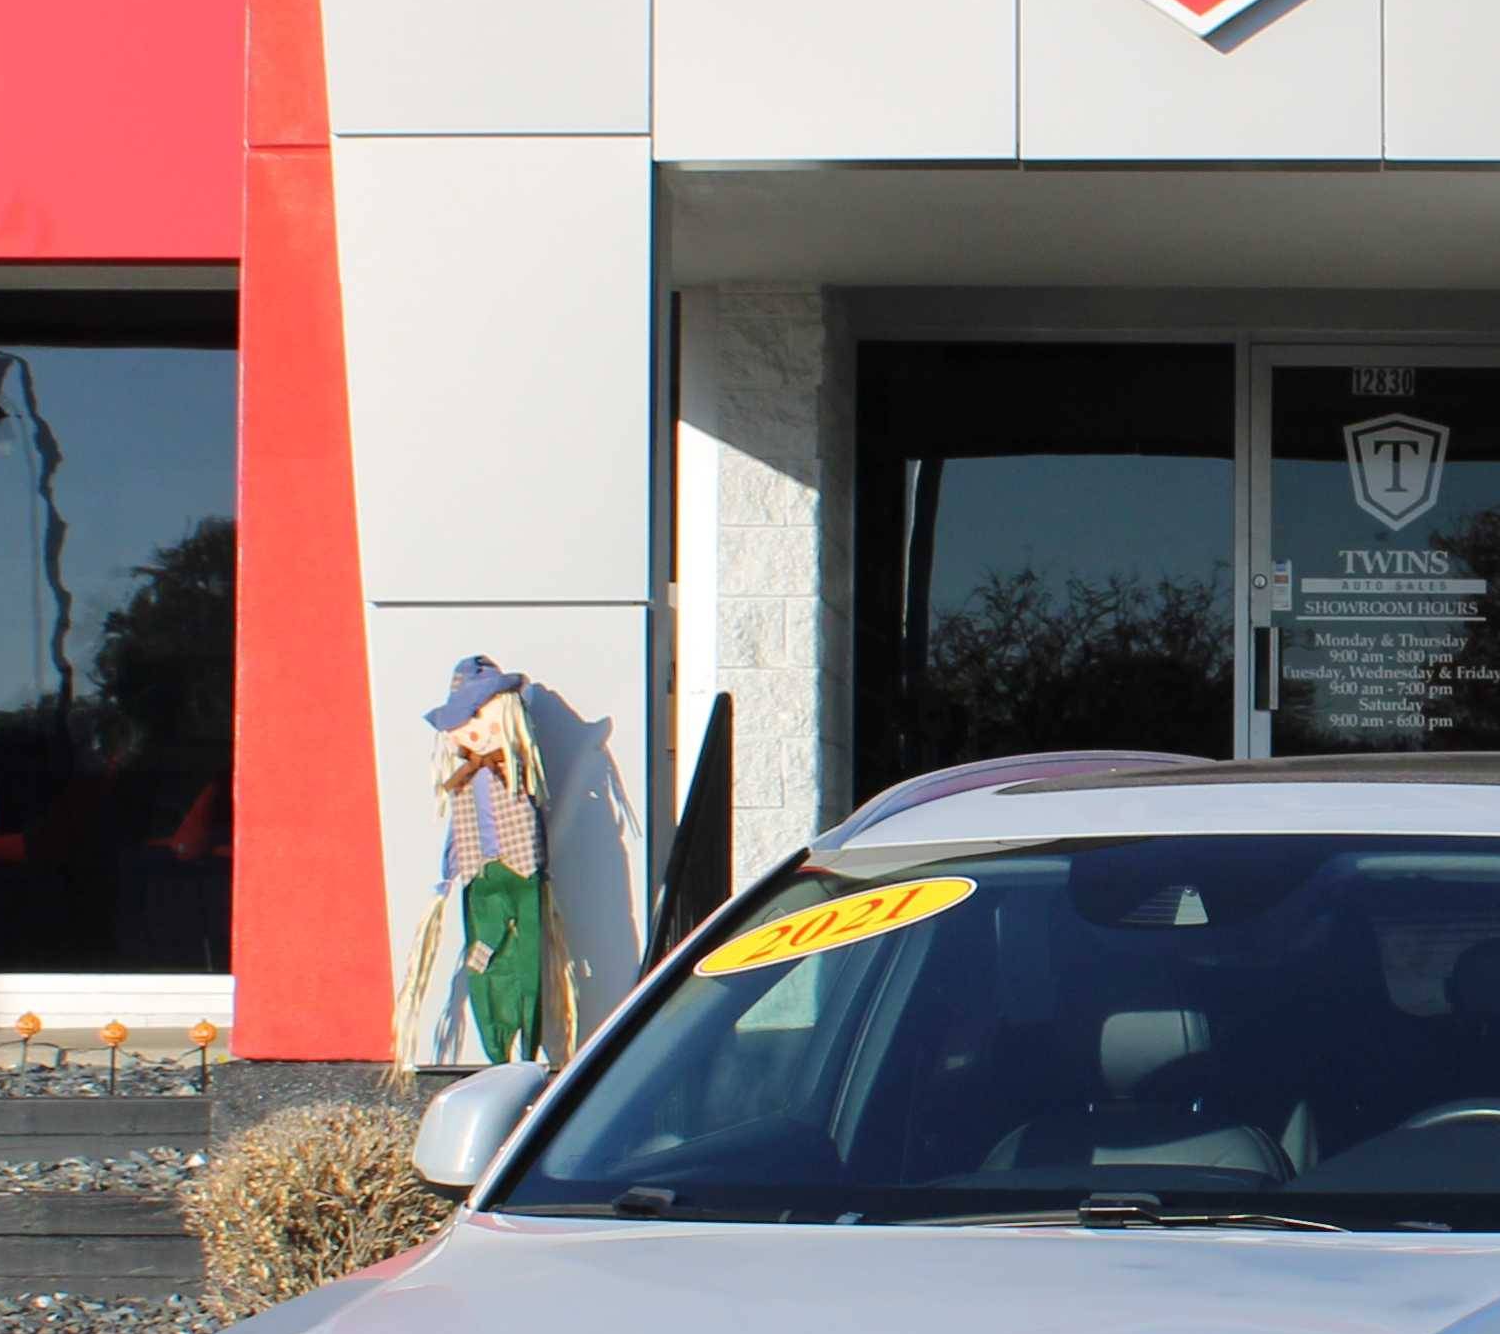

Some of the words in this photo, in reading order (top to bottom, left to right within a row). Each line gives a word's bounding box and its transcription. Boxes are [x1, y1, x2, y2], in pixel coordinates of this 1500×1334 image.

[1353, 368, 1414, 394] 12830
[1373, 440, 1420, 492] T
[1339, 550, 1449, 574] TWINS
[1341, 581, 1383, 591] AUTO
[1395, 581, 1448, 591] SALES
[1304, 601, 1412, 615] SHOWROOM
[1418, 601, 1479, 615] HOURS
[1315, 633, 1375, 648] Monday
[1381, 634, 1394, 647] &
[1399, 633, 1468, 651] Thursday
[1329, 649, 1358, 663] 9:00
[1361, 653, 1384, 663] am
[1396, 649, 1425, 663] 8:00
[1429, 653, 1453, 666] pm
[1349, 665, 1434, 682] Wednesday
[1438, 667, 1452, 680] &
[1329, 681, 1358, 695] 9:00
[1361, 685, 1384, 695] am
[1396, 681, 1425, 695] 7:00
[1429, 685, 1453, 698] pm
[1358, 698, 1424, 713] Saturday
[1329, 713, 1358, 727] 9:00
[1361, 717, 1384, 727] am
[1396, 713, 1425, 727] 6:00
[1429, 717, 1453, 730] pm
[740, 886, 925, 964] 2021
